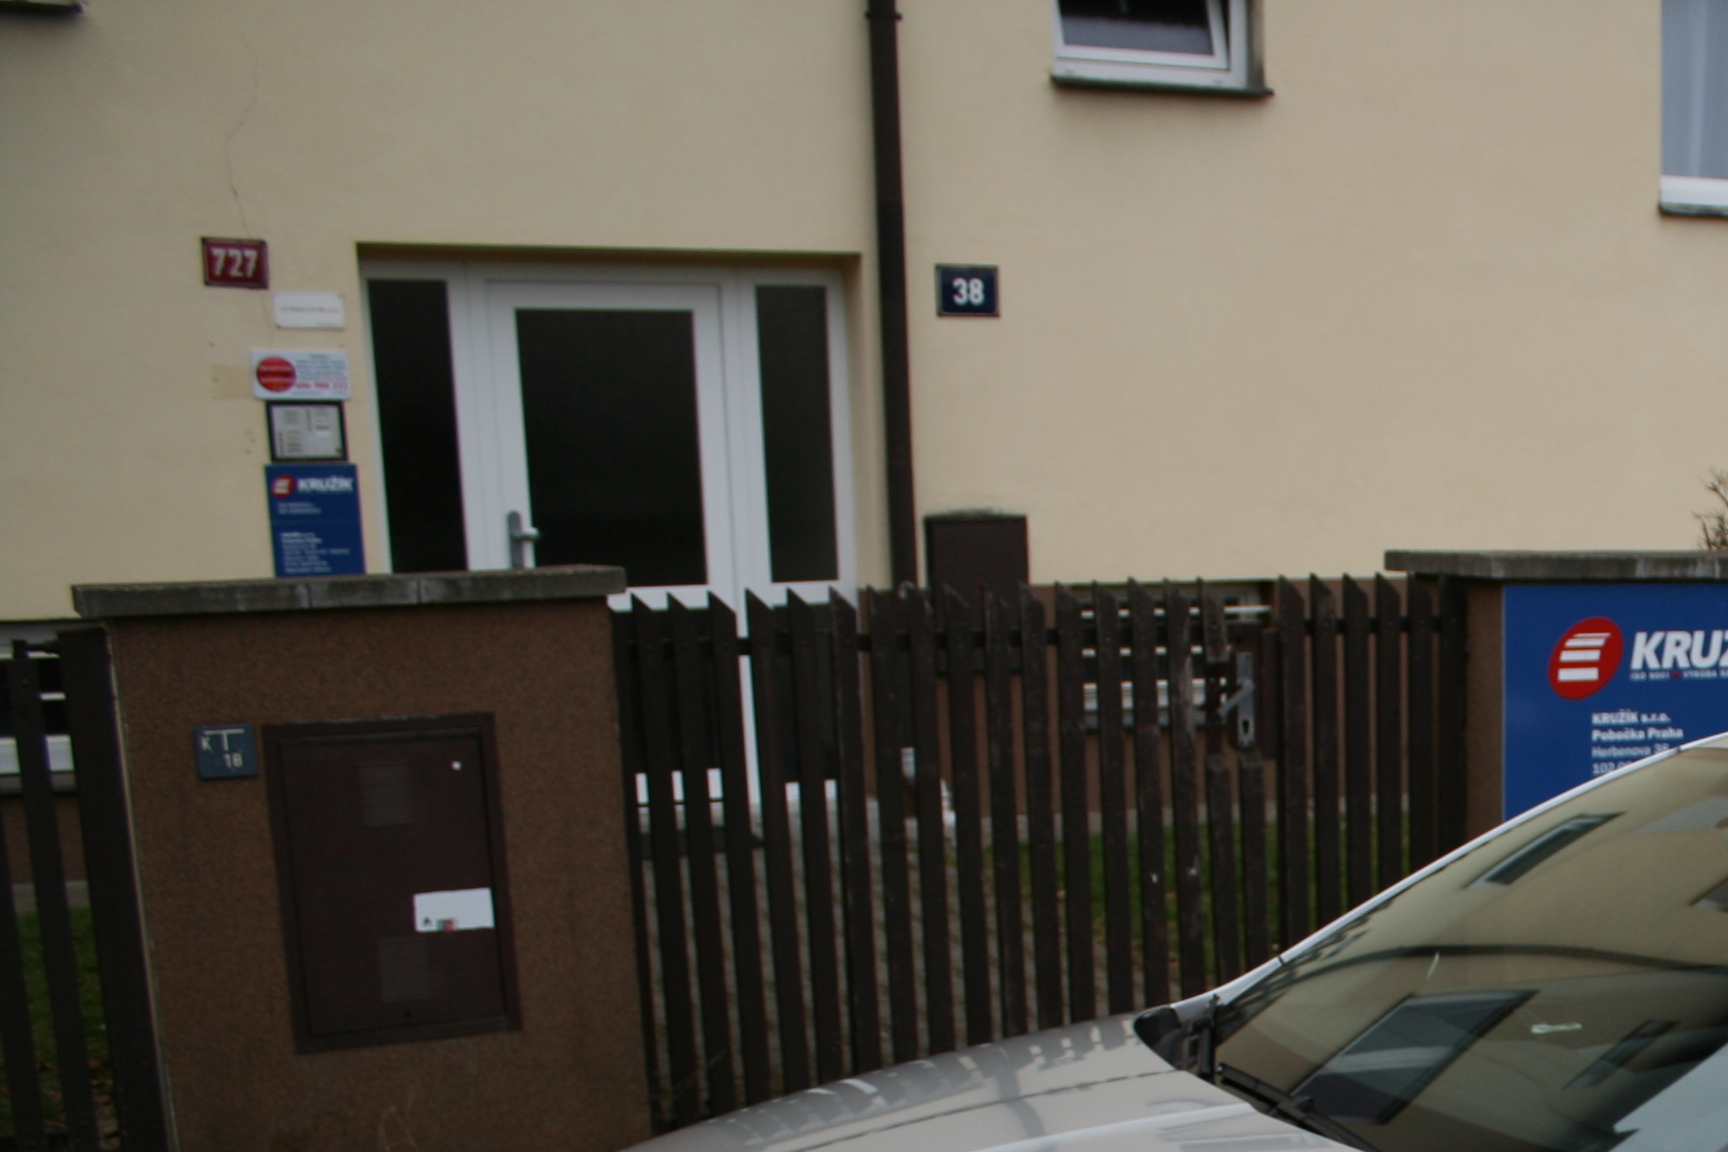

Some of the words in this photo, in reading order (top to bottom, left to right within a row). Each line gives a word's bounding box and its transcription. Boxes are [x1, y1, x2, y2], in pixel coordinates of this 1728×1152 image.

[212, 247, 258, 278] 727
[952, 277, 985, 306] 38
[1647, 727, 1684, 740] Praha
